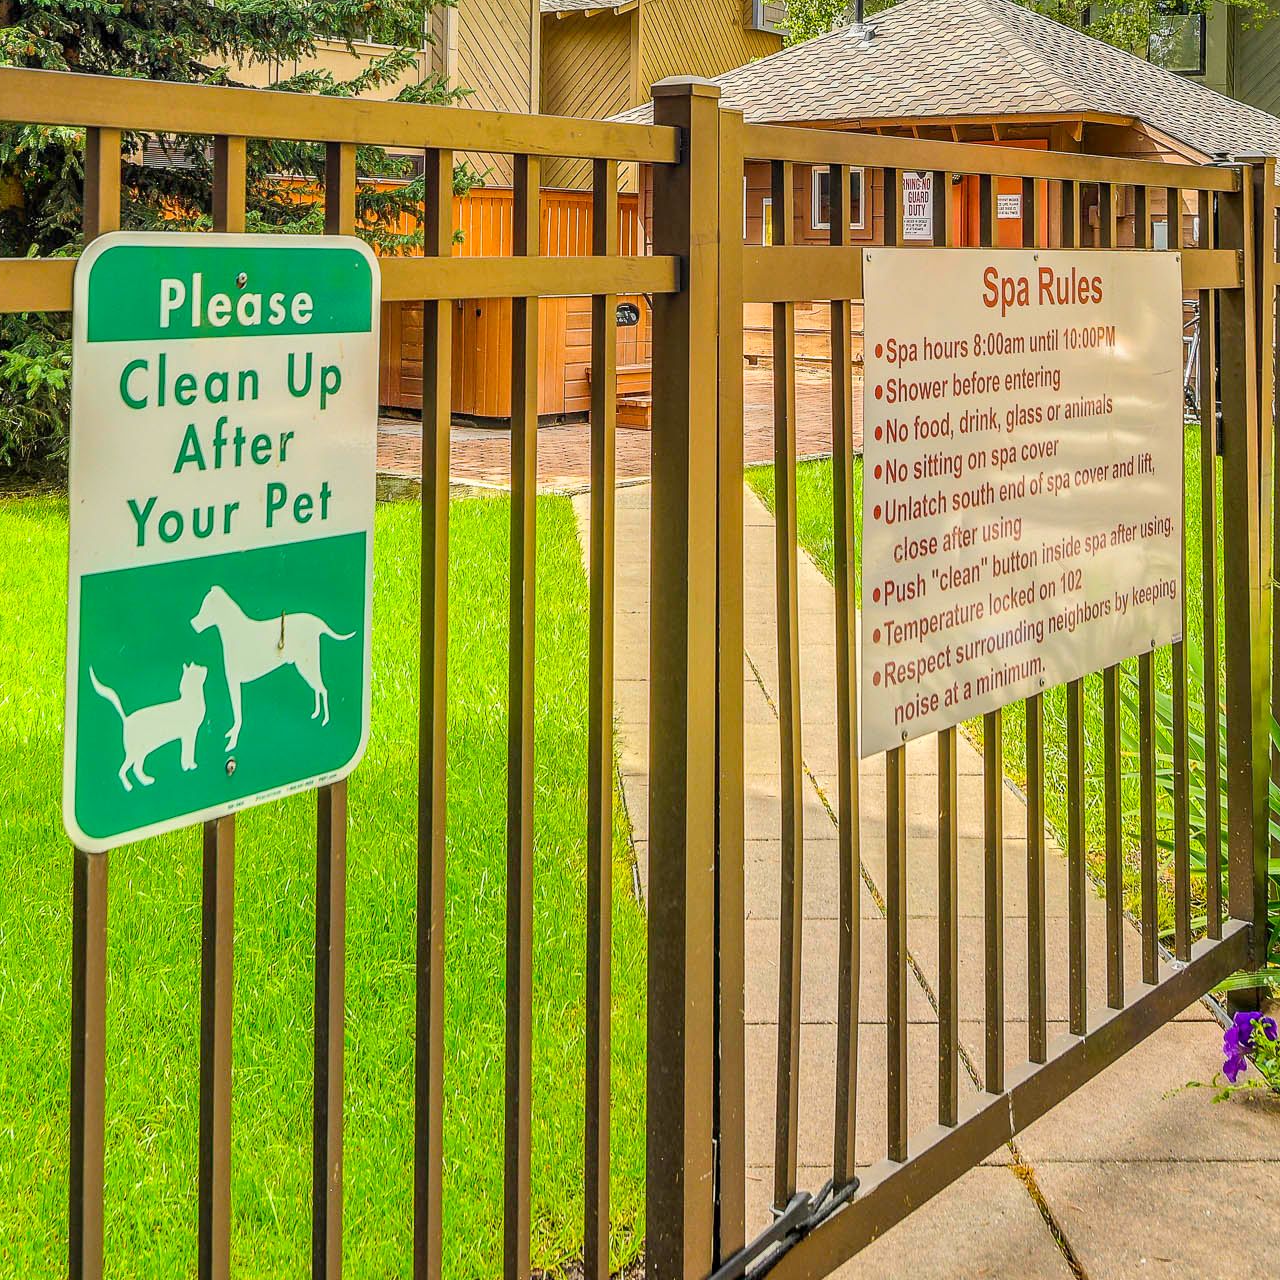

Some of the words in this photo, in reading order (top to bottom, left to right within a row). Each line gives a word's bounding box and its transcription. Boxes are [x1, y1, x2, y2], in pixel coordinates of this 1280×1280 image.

[909, 204, 926, 216] DUTY
[160, 272, 313, 328] Please
[982, 266, 1030, 318] Spa
[1038, 267, 1103, 306] Rules
[886, 338, 918, 369] Spa
[924, 336, 968, 361] hours
[973, 332, 1025, 357] 8:00am
[1030, 329, 1058, 353] until
[1063, 325, 1116, 350] 10:00PM
[120, 353, 259, 410] Clean
[287, 352, 342, 410] Up
[886, 378, 948, 404] Shower
[953, 371, 1000, 397] before
[1005, 365, 1061, 392] entering
[173, 416, 294, 474] After
[886, 418, 909, 444] No
[914, 412, 954, 441] food,
[959, 407, 1001, 434] drink,
[1006, 404, 1043, 433] glass
[1047, 404, 1061, 422] or
[1064, 393, 1113, 420] animals
[885, 490, 947, 525] Unlatch
[952, 482, 995, 511] south
[999, 475, 1025, 502] end
[1030, 471, 1044, 496] of
[1047, 473, 1070, 497] spa
[1074, 465, 1110, 486] cover
[1112, 456, 1134, 479] and
[1138, 452, 1155, 476] lift,
[886, 459, 908, 485] No
[913, 451, 963, 480] sitting
[968, 451, 986, 470] on
[991, 446, 1017, 471] spa
[1021, 440, 1059, 461] cover
[127, 496, 240, 547] Your
[266, 482, 332, 528] Pet
[894, 536, 938, 563] close
[943, 526, 978, 552] after
[982, 515, 1022, 543] using
[884, 573, 926, 607] Push
[932, 557, 988, 591] "clean"
[993, 550, 1037, 578] button
[1042, 535, 1081, 565] inside
[1085, 533, 1107, 557] spa
[1111, 523, 1138, 546] after
[1140, 515, 1174, 539] using.
[884, 602, 984, 646] Temperature
[989, 580, 1035, 616] locked
[1039, 581, 1056, 601] on
[1060, 568, 1082, 594] 102
[885, 649, 952, 689] Respect
[956, 620, 1044, 664] surrounding
[1048, 600, 1111, 634] neighbors
[1115, 591, 1129, 615] by
[1132, 578, 1176, 607] keeping
[895, 693, 939, 726] noise
[944, 681, 959, 707] at
[963, 682, 972, 700] a
[977, 657, 1045, 696] minimum.
